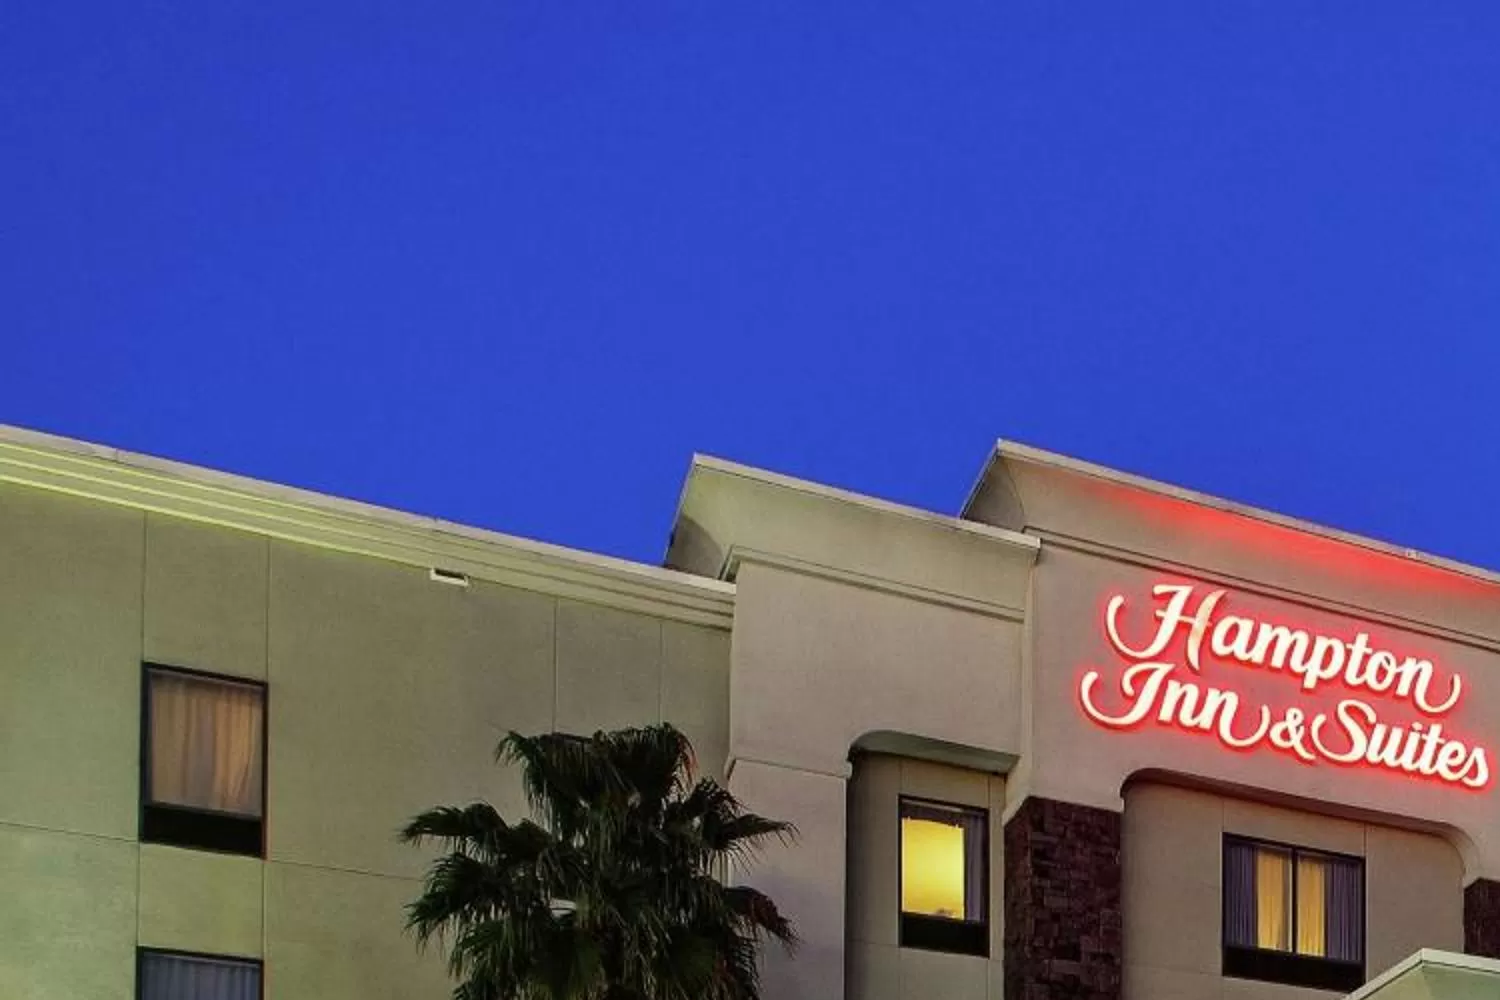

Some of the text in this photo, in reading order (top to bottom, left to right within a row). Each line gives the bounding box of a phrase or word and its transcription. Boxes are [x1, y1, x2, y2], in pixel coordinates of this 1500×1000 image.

[1106, 584, 1461, 713] Hampton
[1081, 664, 1269, 747] Inn
[1311, 699, 1489, 787] Suites
